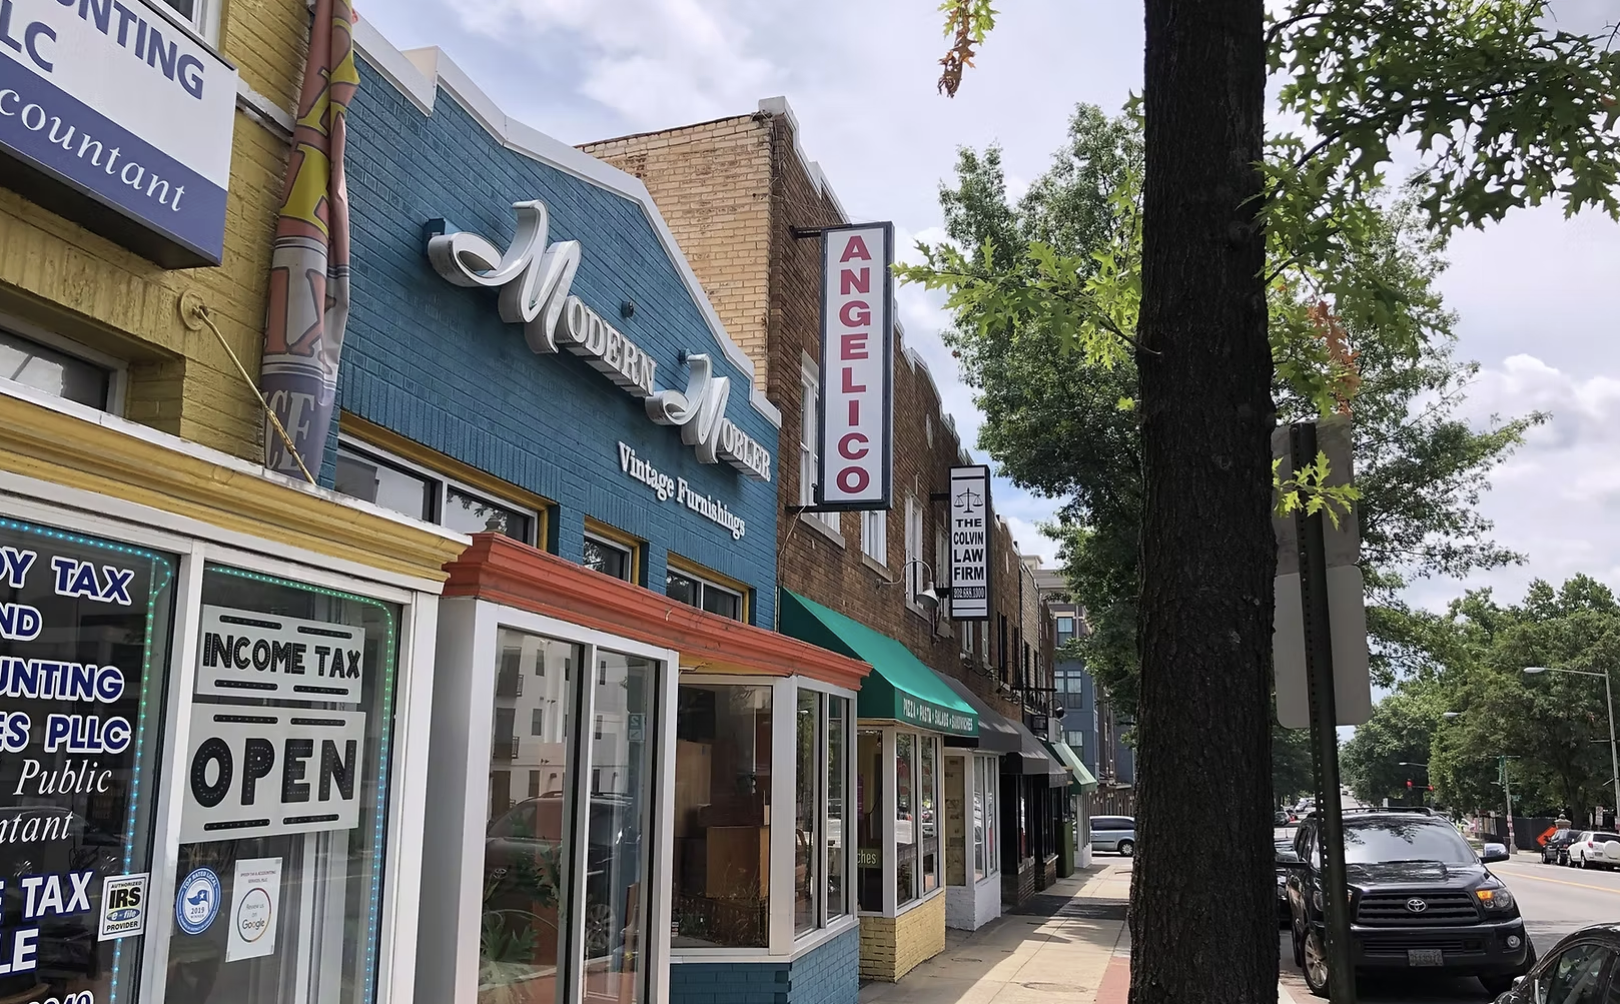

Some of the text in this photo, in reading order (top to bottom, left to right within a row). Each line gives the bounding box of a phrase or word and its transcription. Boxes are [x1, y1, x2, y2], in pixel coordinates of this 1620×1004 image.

[55, 0, 204, 100] NTING
[0, 89, 185, 211] countant
[836, 235, 871, 494] ANGELICO
[618, 441, 745, 540] Vintage Furnishings
[953, 531, 984, 545] COLVIN
[955, 518, 982, 528] THE
[953, 549, 984, 563] LAW
[953, 566, 984, 580] FIRM
[0, 545, 135, 606] Y TAX
[202, 632, 361, 680] INCOME TAX
[903, 698, 917, 718] PIZZA
[919, 704, 932, 724] PASTA
[934, 709, 949, 728] SALADS
[44, 713, 132, 754] PLLC
[13, 759, 112, 796] Public
[190, 737, 357, 808] OPEN
[21, 871, 93, 919] TAX
[109, 887, 141, 909] IRS
[111, 881, 142, 889] AUTHORIZED
[106, 921, 138, 931] PROVIDER
[242, 918, 265, 930] Google
